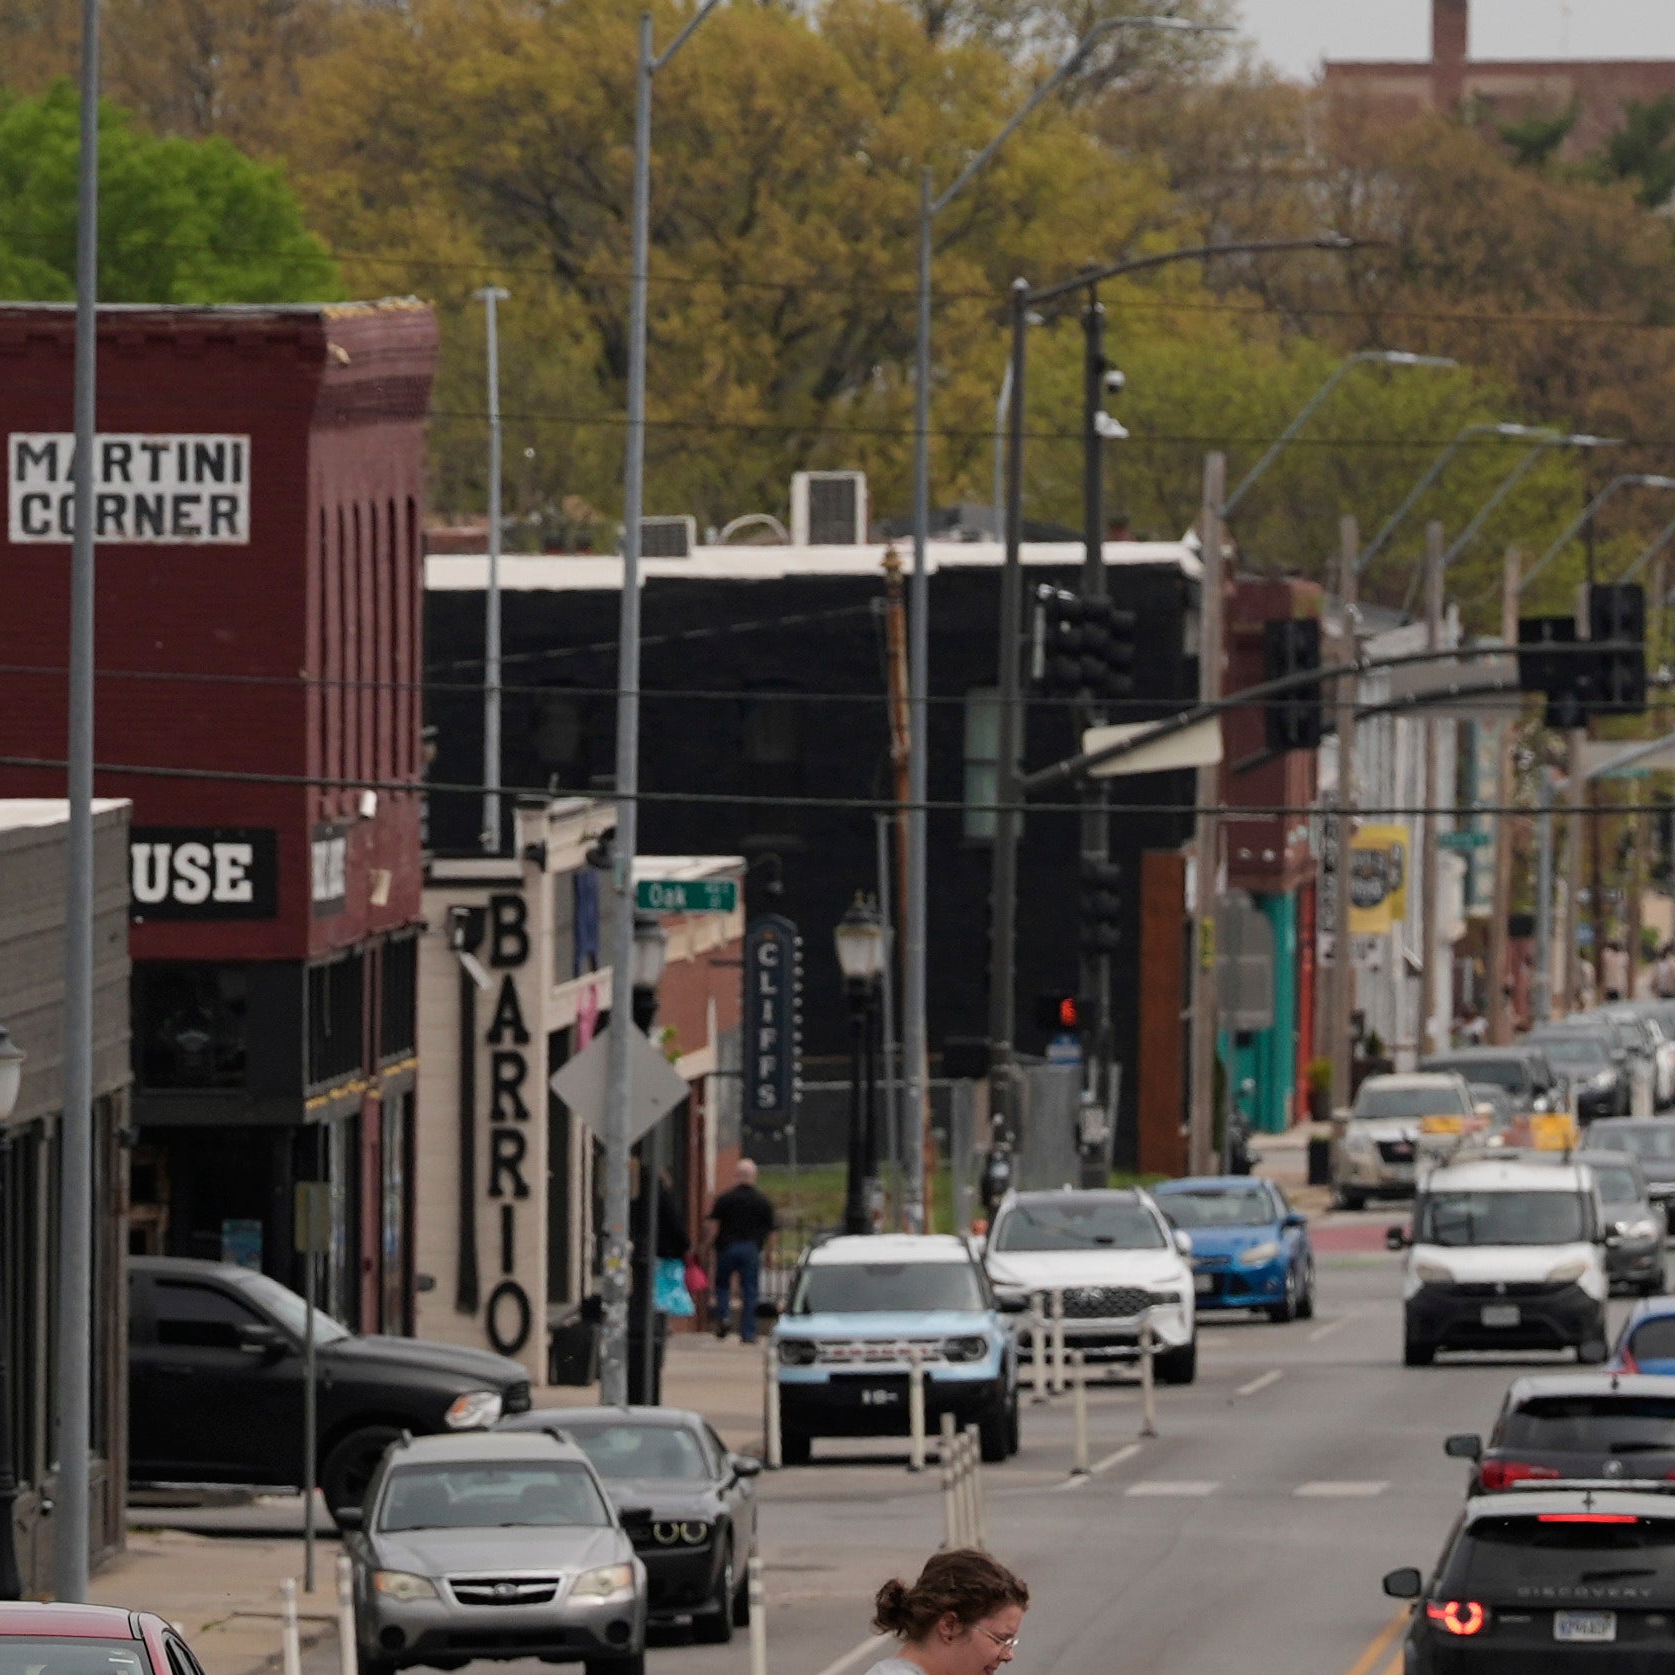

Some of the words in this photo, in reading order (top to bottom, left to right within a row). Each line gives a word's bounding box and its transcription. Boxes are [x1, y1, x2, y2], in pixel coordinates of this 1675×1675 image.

[16, 441, 241, 483] MRTINI
[648, 883, 686, 907] Oak
[757, 942, 779, 1109] CLIFFS
[486, 895, 531, 1356] BARRIO
[1516, 1586, 1653, 1599] DISCOVERY
